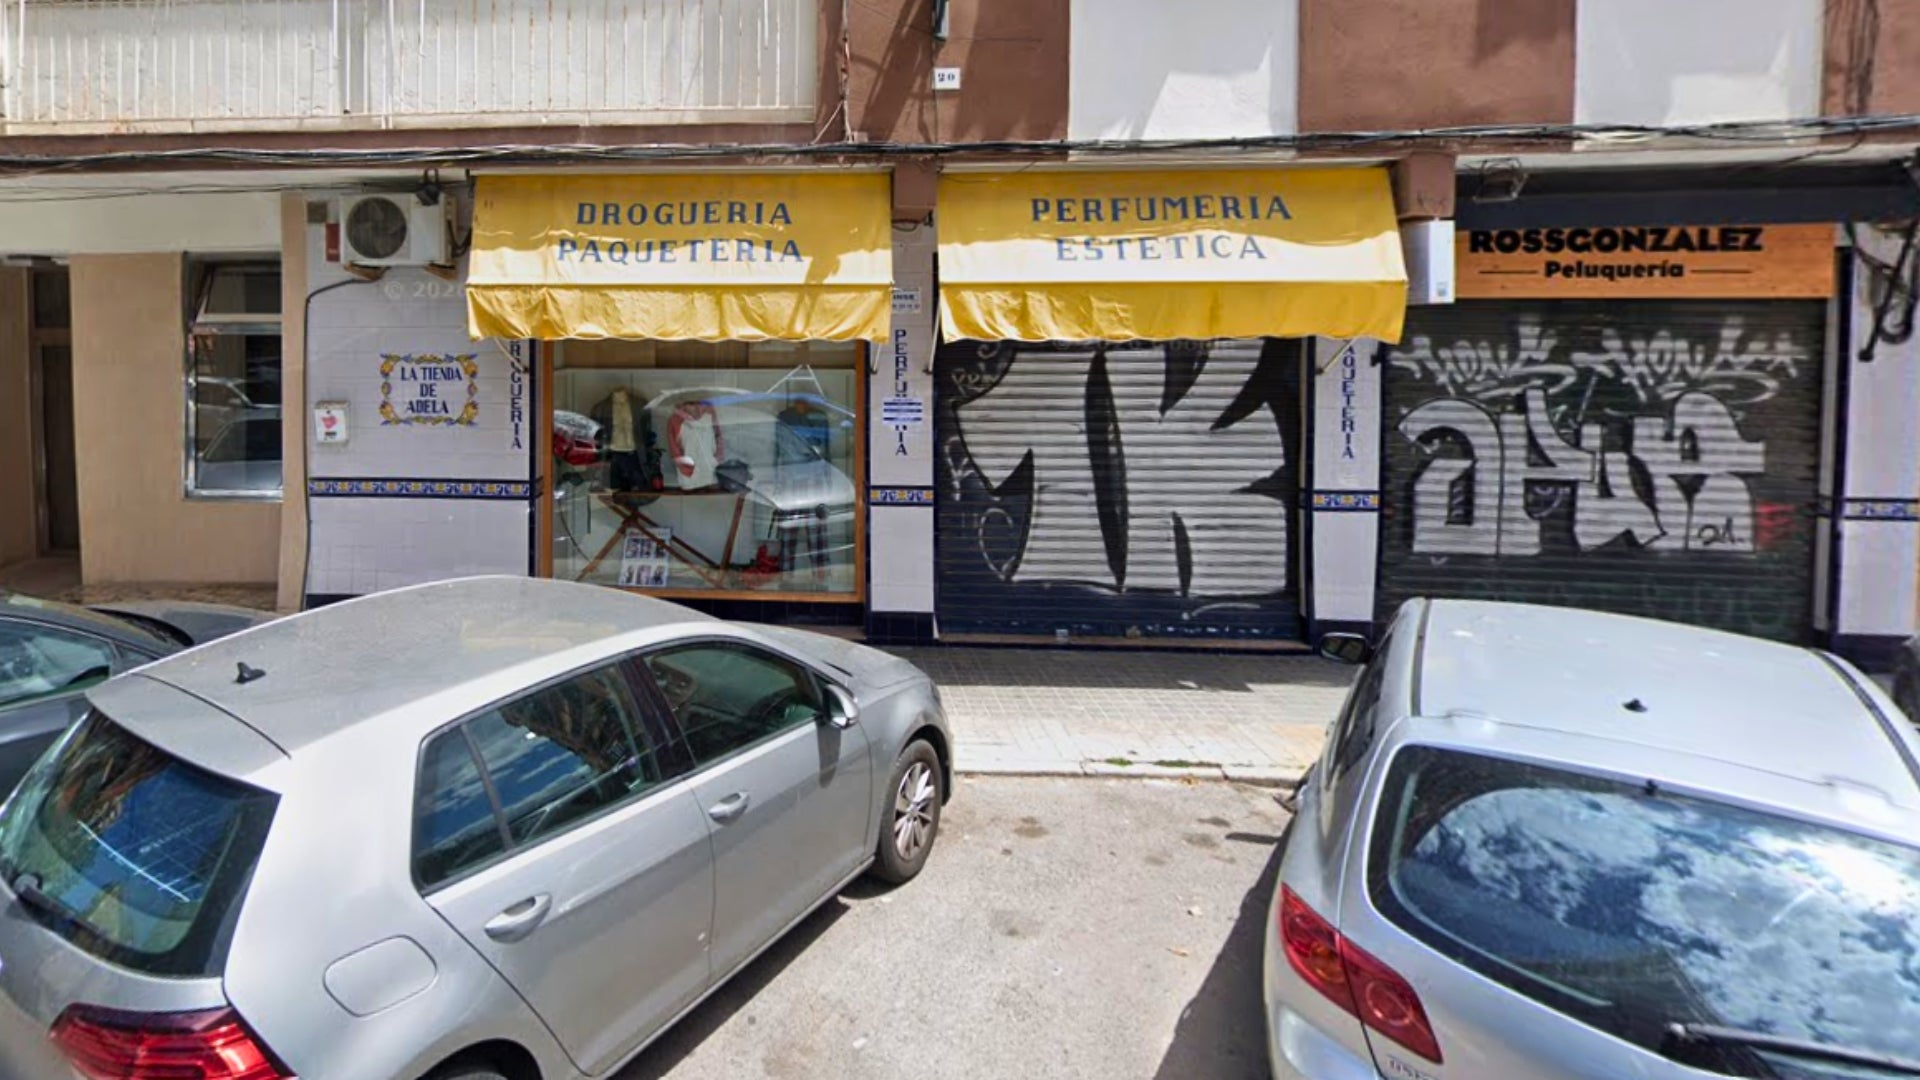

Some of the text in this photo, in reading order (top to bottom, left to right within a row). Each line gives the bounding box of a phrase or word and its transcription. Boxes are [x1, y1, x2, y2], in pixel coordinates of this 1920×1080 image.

[577, 201, 792, 225] DROGUERIA
[1031, 195, 1292, 222] PERFUMERIA
[558, 239, 804, 265] PAQUETERIA
[1056, 235, 1267, 261] ESTETICA
[1469, 228, 1763, 253] ROSSGONZALEZ
[1545, 260, 1684, 281] Peluquería
[401, 367, 463, 381] LA TIENDA
[420, 383, 437, 397] DE
[894, 329, 908, 456] PERFUIA
[1342, 340, 1355, 459] AQUETERIA
[406, 400, 449, 414] ADELA
